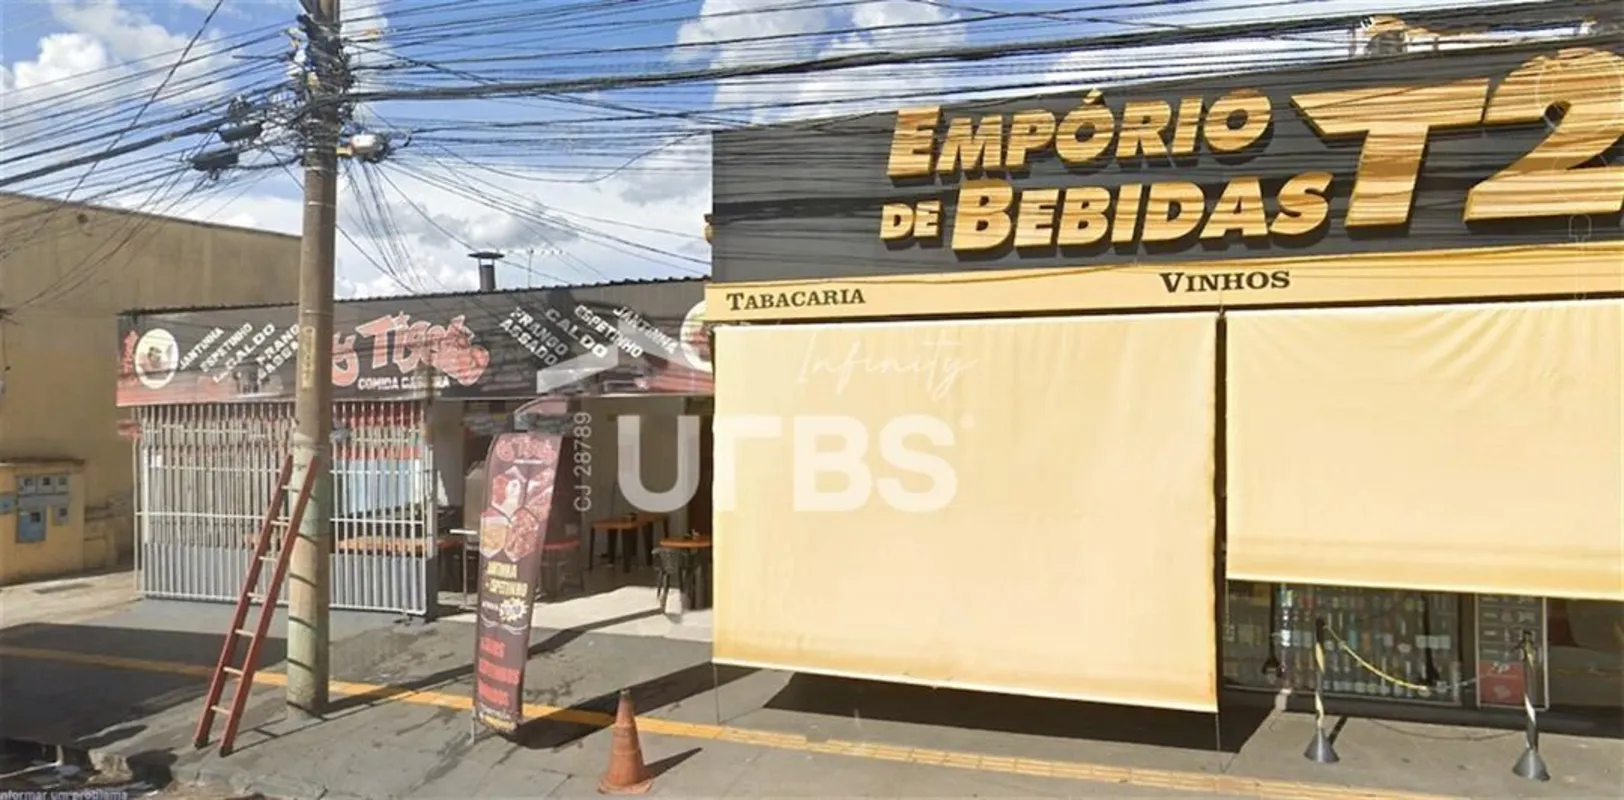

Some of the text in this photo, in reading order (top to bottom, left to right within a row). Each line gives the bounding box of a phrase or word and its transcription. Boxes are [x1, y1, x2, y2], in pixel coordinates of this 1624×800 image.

[887, 87, 1272, 177] EMPÓRIO
[1290, 47, 1624, 228] T2
[880, 171, 1333, 252] DE BEBIDAS
[726, 288, 866, 311] TABACARIA
[1159, 270, 1291, 293] VINHOS
[200, 322, 254, 372] ESPETINHO
[225, 323, 276, 370] CALDO
[499, 318, 559, 366] ASSADO
[508, 306, 568, 357] FRANGO
[545, 308, 608, 358] CALDO
[573, 304, 644, 359] ESPETINHO
[357, 376, 399, 391] COMIDA
